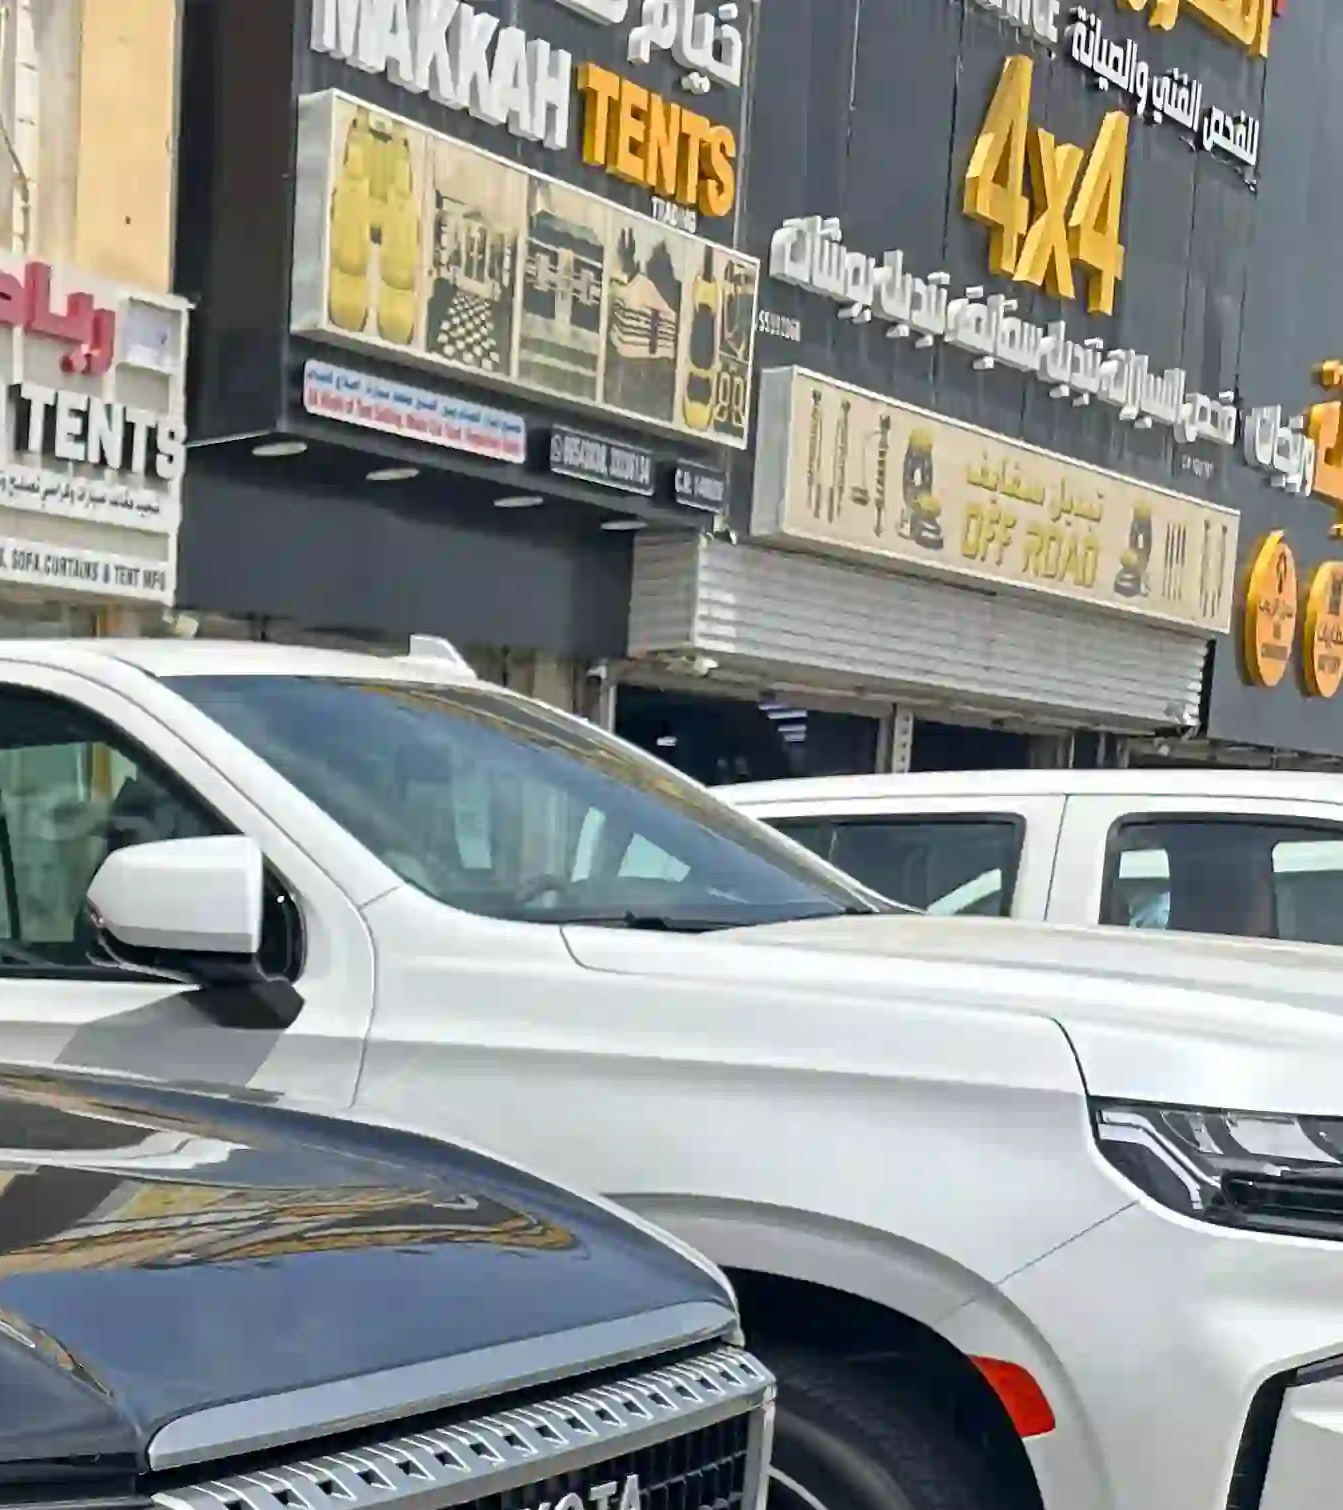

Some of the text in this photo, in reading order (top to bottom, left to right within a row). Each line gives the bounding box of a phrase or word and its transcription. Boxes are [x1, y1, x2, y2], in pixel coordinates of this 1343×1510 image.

[310, 0, 736, 217] MAKKAH TENTS
[17, 381, 188, 482] TENTS
[960, 501, 1099, 588] OFF ROAD
